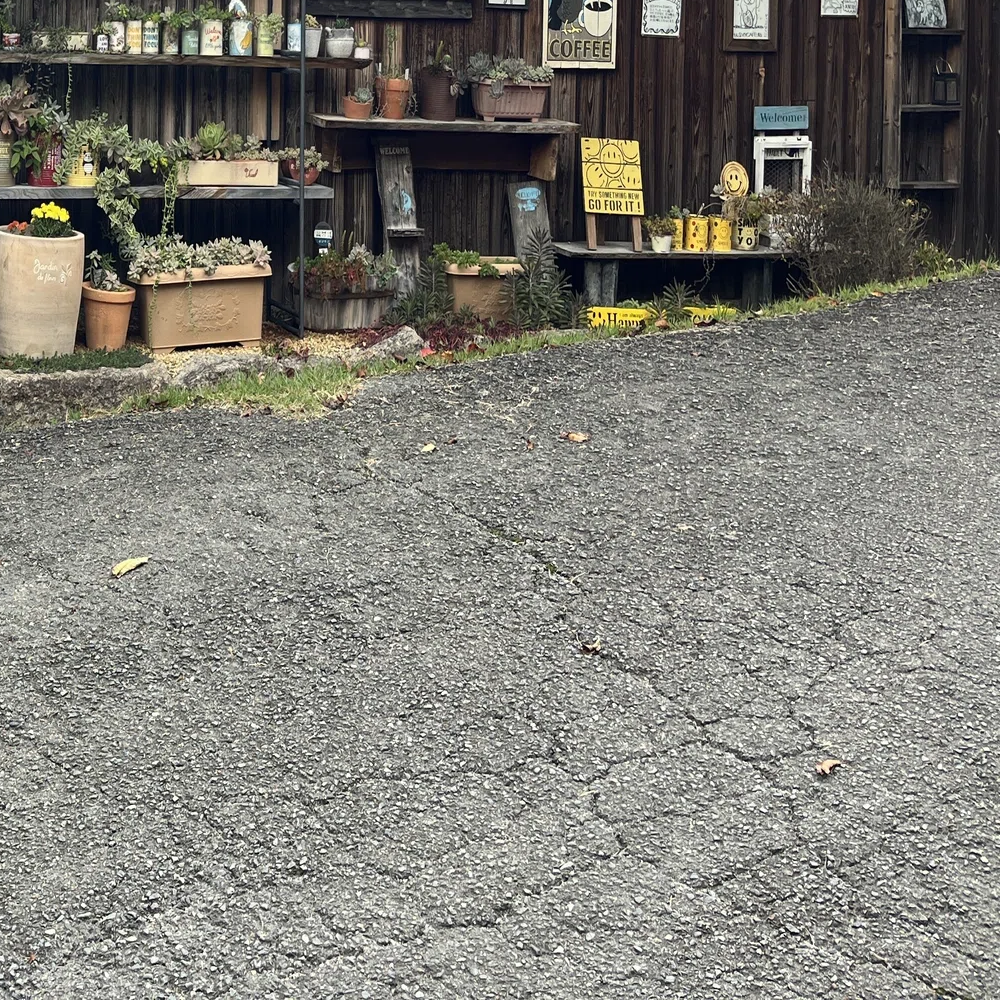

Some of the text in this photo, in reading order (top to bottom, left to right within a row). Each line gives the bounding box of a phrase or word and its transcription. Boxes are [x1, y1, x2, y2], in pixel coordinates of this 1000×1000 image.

[549, 39, 611, 58] COFFEE
[760, 113, 803, 123] Welcome
[380, 147, 409, 155] WELCOME
[599, 191, 627, 199] SOMETHING
[588, 199, 601, 211] GO
[604, 200, 622, 212] FOR
[33, 258, 58, 274] Jardin
[607, 312, 645, 330] Happ
